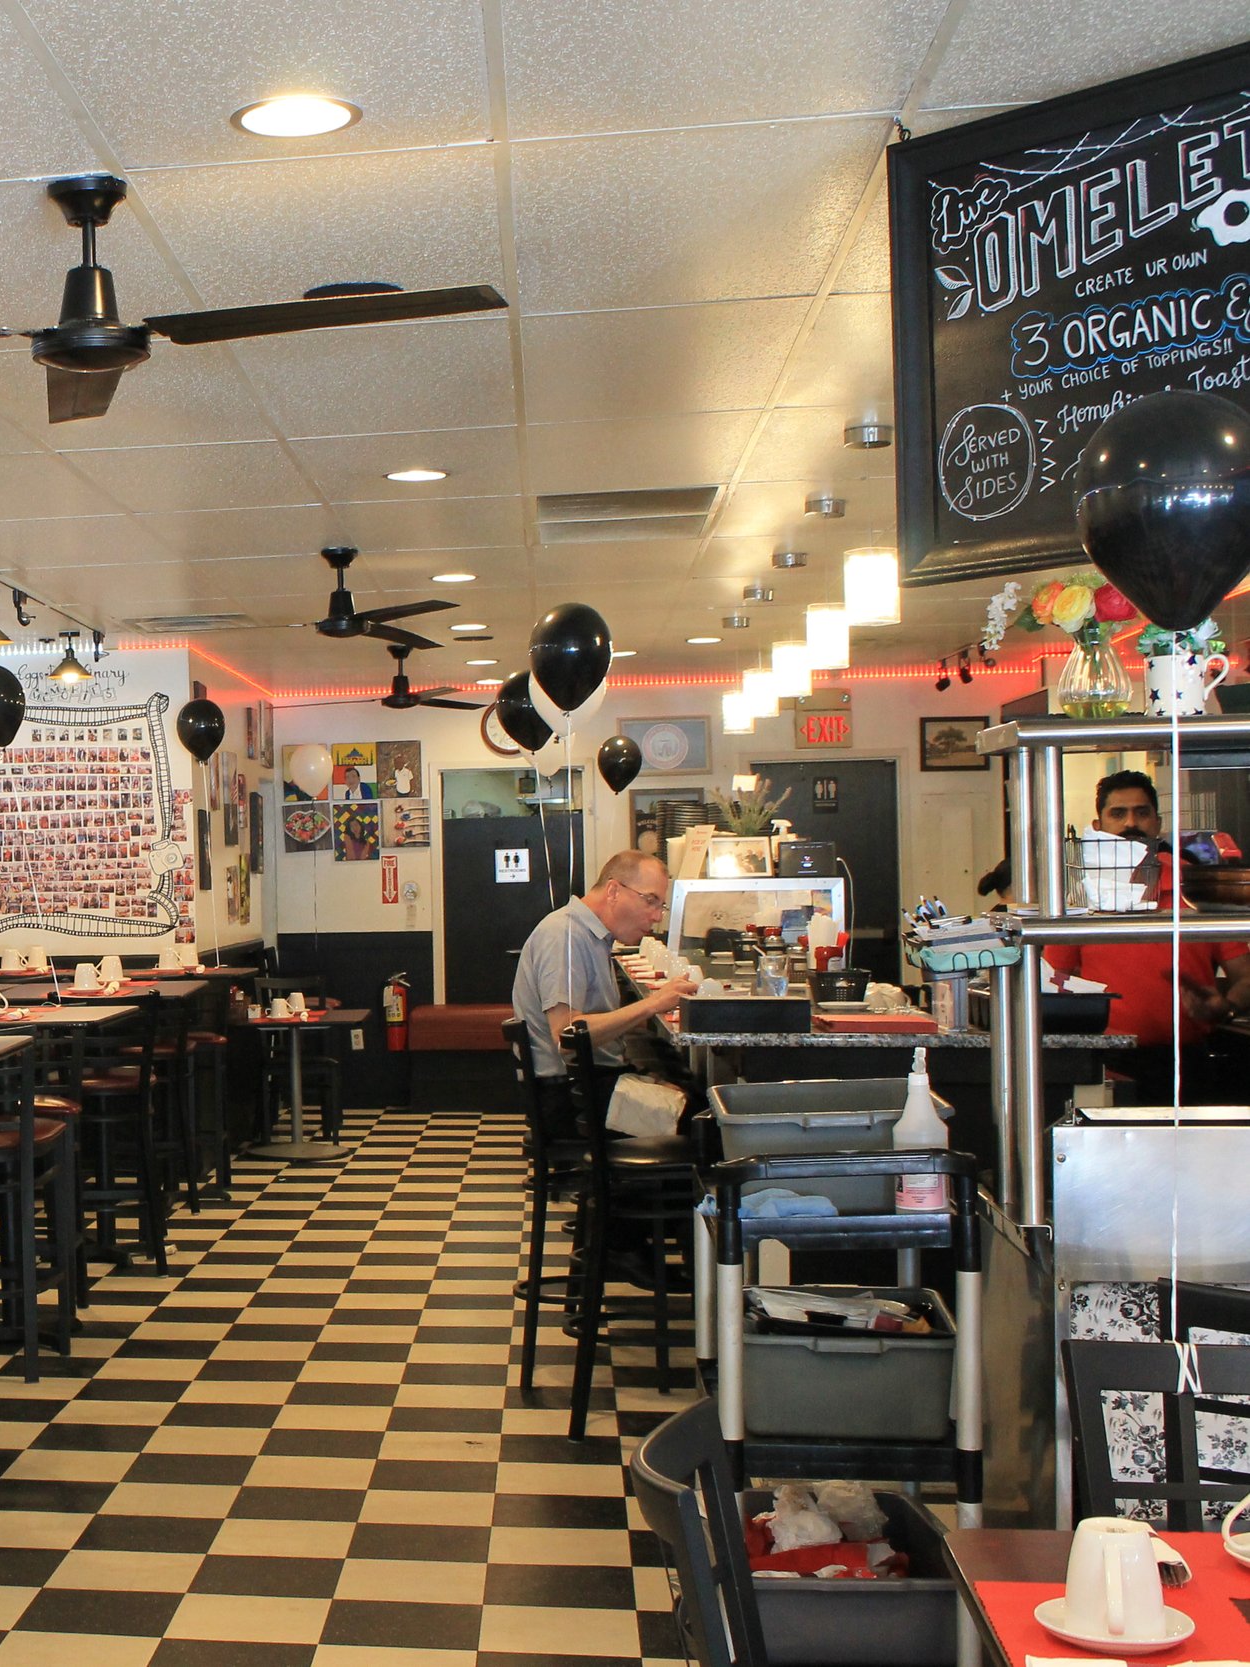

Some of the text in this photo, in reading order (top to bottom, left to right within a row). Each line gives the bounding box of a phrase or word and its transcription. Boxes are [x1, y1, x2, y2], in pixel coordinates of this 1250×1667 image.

[936, 188, 1001, 242] Live
[1075, 248, 1207, 298] CREATE UR OWN
[1021, 322, 1050, 367] 3
[1062, 294, 1213, 360] ORGANIC
[1018, 377, 1053, 400] YOUR
[1061, 366, 1111, 389] CHOICE
[1121, 359, 1140, 375] OF
[1145, 337, 1233, 369] TOPPINGS!!
[947, 424, 1021, 467] SERVED
[971, 451, 1009, 473] WITH
[949, 472, 1017, 511] SIDES
[807, 716, 845, 743] EXIT
[383, 860, 395, 868] FIRE
